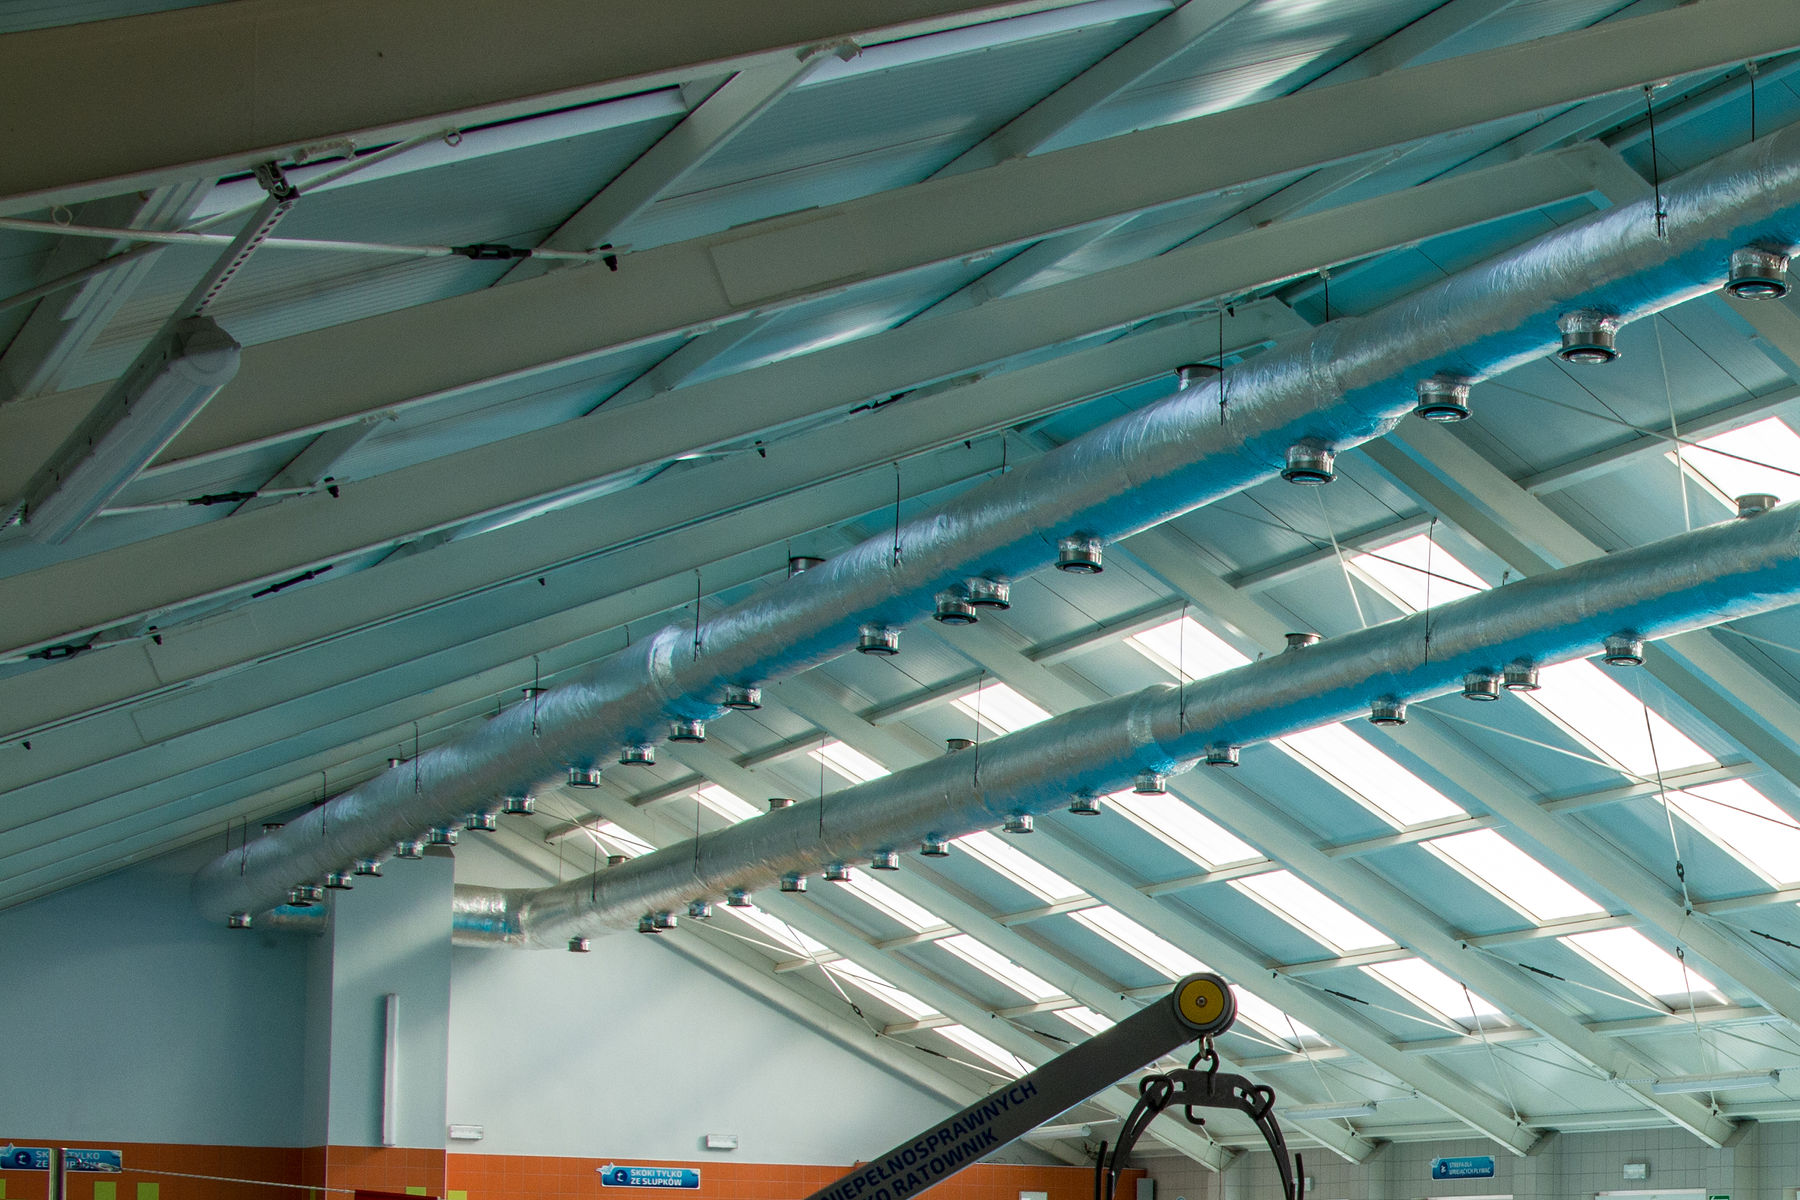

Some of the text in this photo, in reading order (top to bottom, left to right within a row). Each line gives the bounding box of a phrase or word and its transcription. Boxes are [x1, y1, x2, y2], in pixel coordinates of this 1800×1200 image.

[630, 1169, 683, 1178] SKOKI TYLKO
[891, 1127, 999, 1198] RATOWNIK
